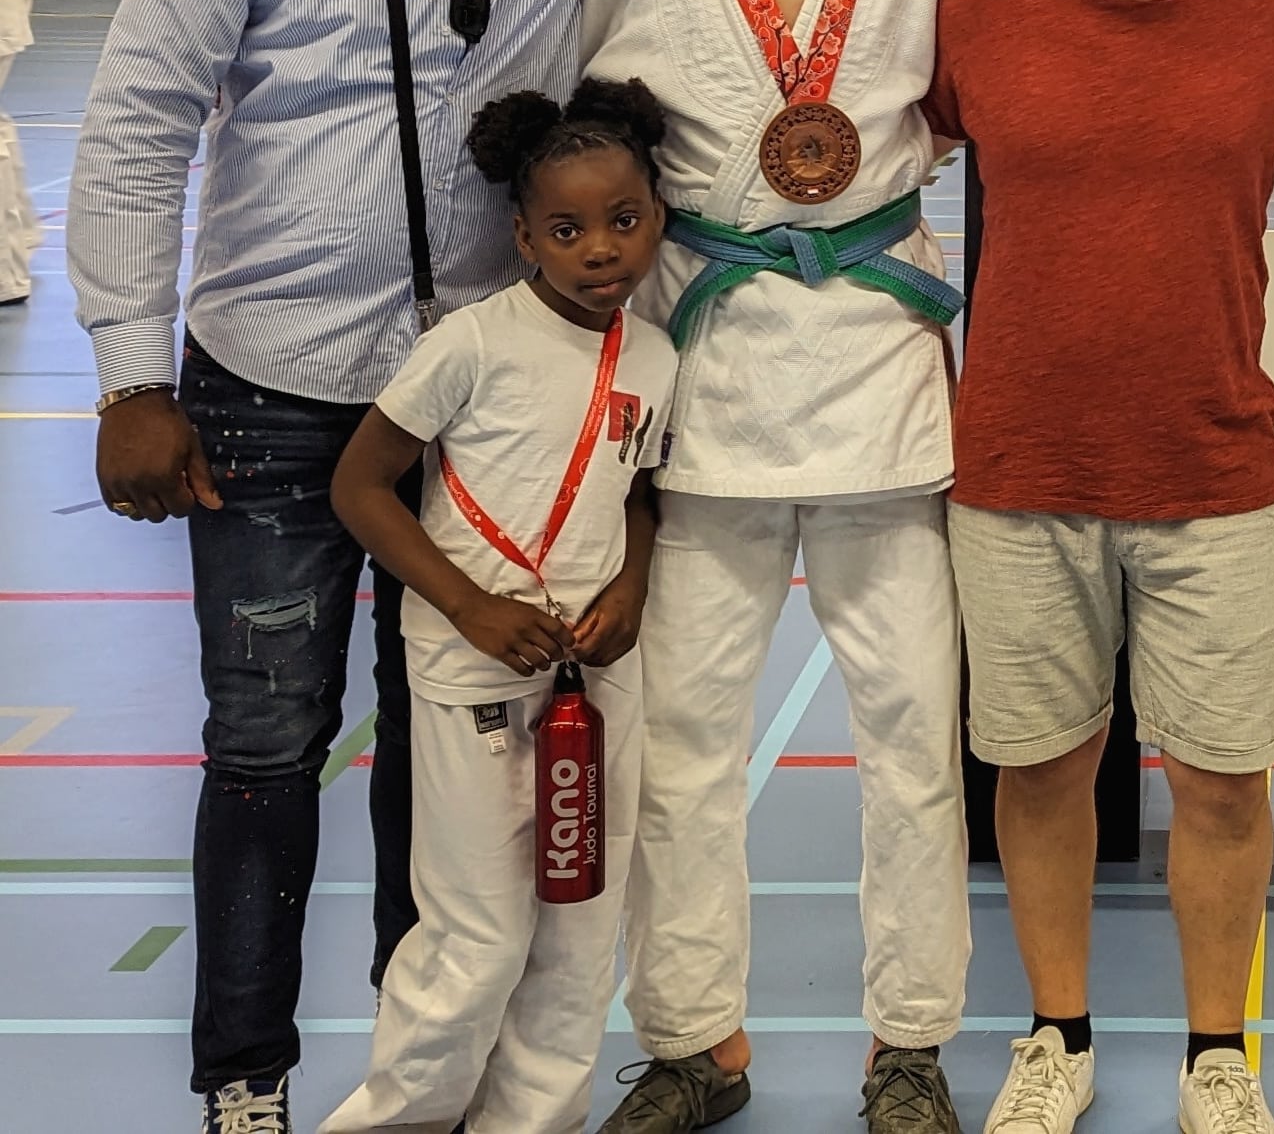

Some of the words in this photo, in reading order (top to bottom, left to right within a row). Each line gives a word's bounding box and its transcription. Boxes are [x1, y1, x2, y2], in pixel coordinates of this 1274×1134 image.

[546, 759, 580, 879] Kano
[583, 763, 597, 824] Tournai
[583, 826, 597, 865] Judo
